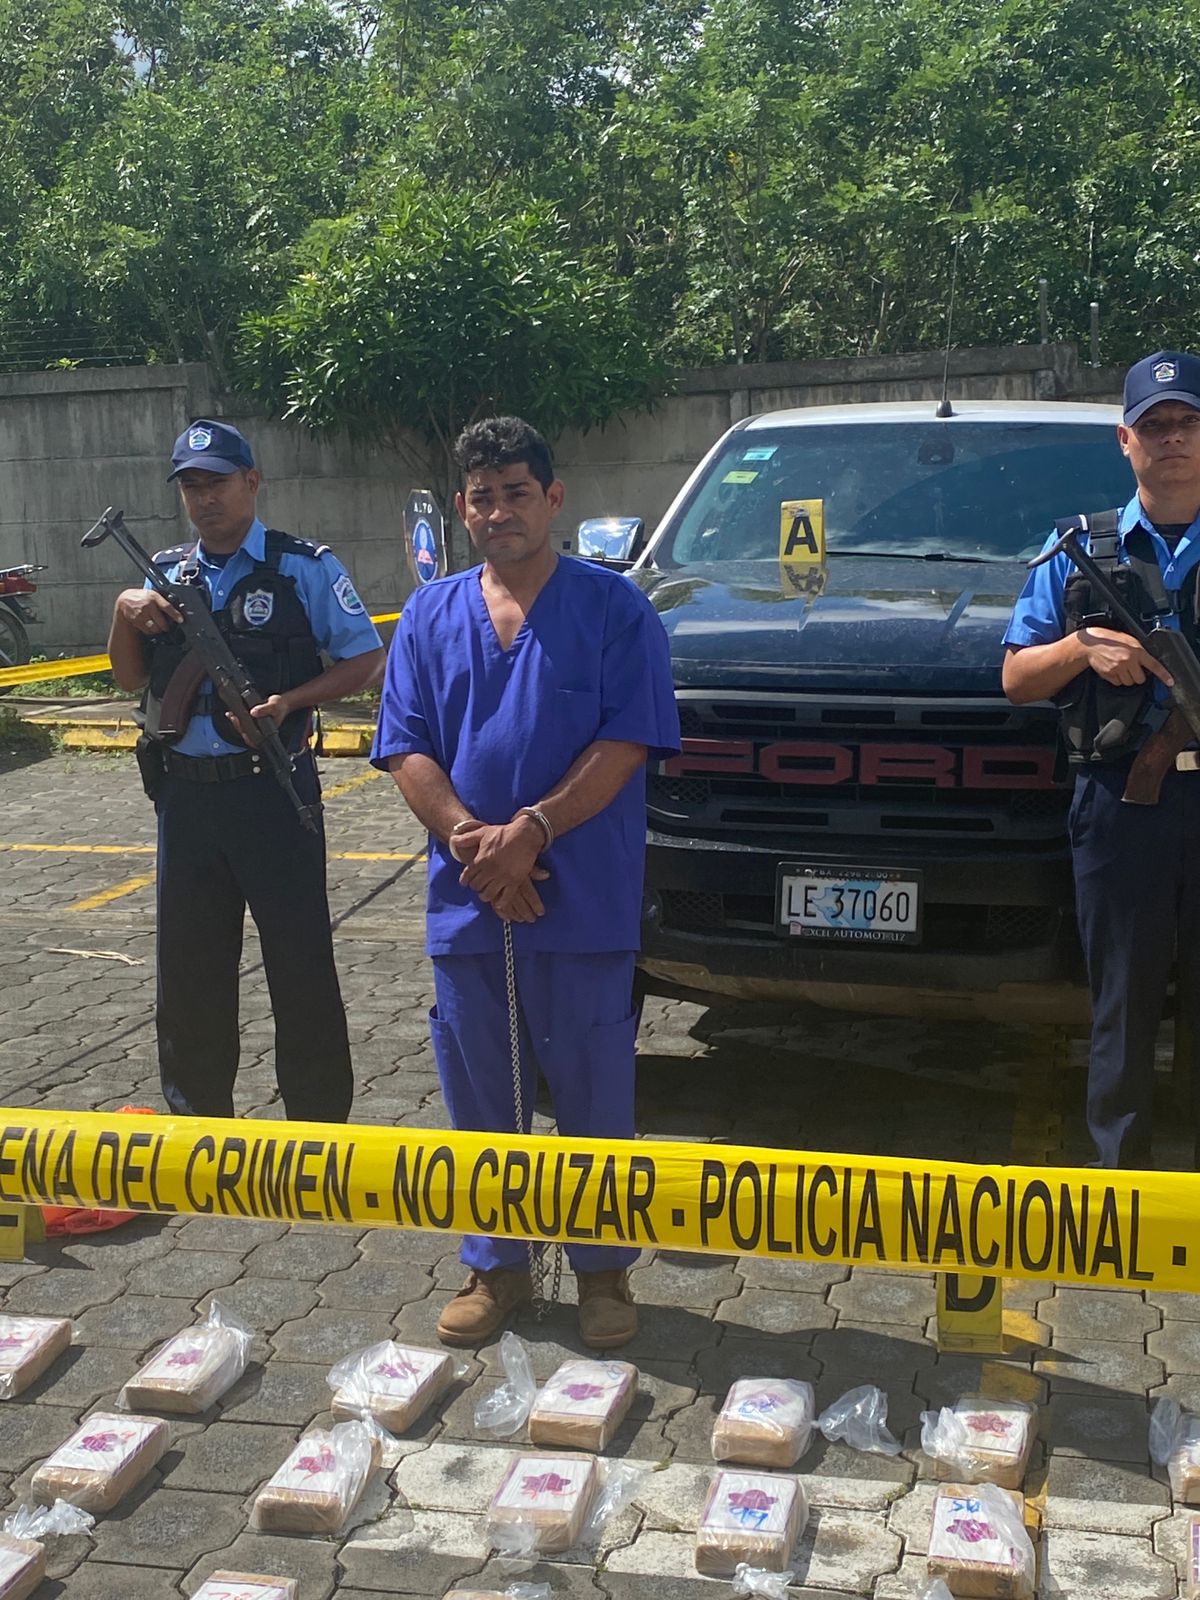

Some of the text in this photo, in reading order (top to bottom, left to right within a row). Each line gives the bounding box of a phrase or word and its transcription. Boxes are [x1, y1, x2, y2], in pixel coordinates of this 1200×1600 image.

[413, 502, 433, 514] ALTO
[783, 509, 819, 556] A
[664, 737, 1060, 790] FORD
[787, 885, 910, 923] LE 37060
[91, 1131, 178, 1212] DEL
[184, 1134, 356, 1222] CRIMEN
[392, 1144, 456, 1229] NO
[469, 1147, 659, 1243] CRUZAR
[700, 1159, 888, 1261] POLICIA
[900, 1171, 1155, 1282] NACIONAL
